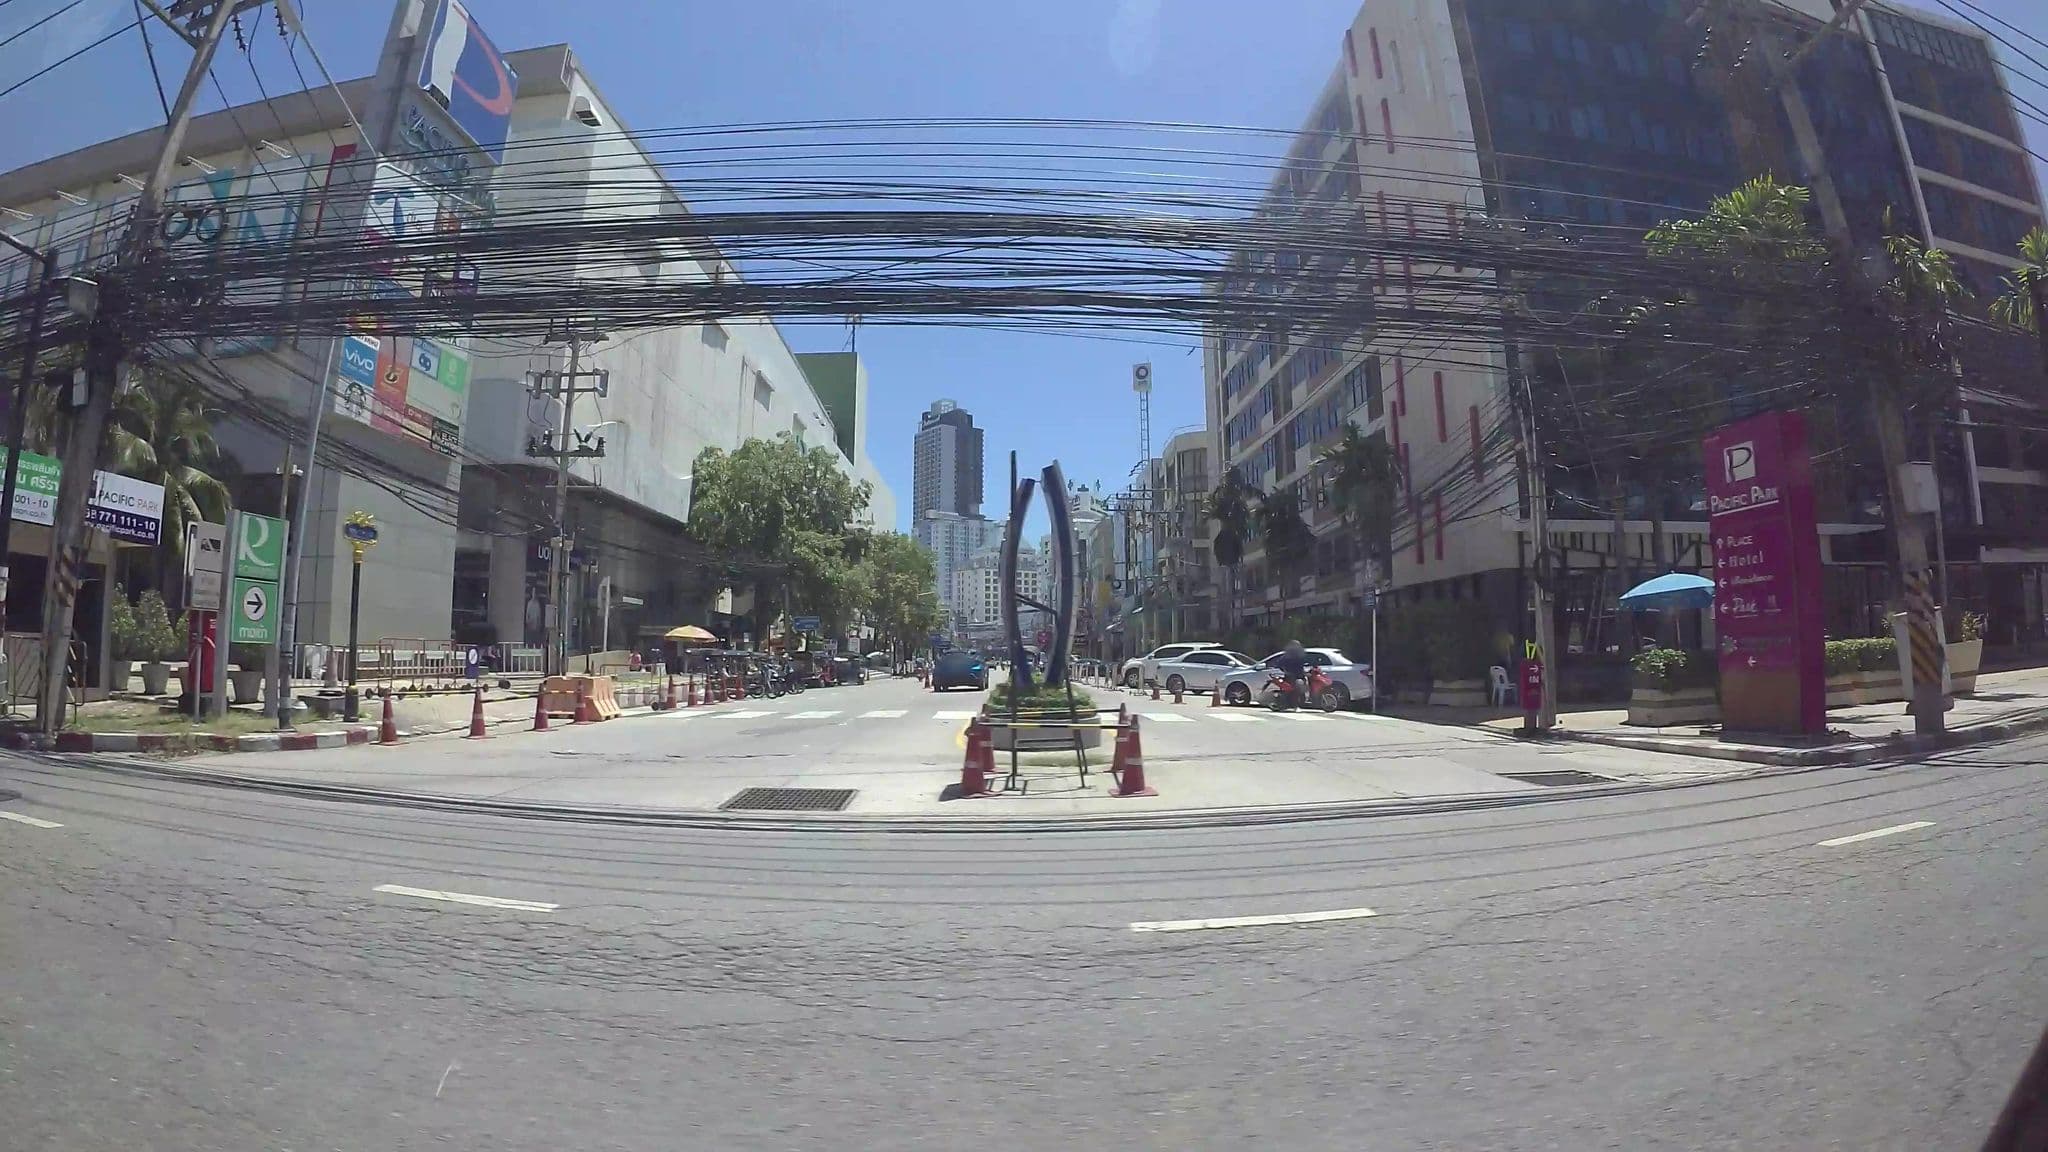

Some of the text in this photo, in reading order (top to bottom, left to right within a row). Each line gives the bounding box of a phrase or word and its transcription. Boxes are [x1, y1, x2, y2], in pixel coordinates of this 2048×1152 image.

[345, 348, 375, 372] vivo
[99, 489, 159, 513] PACIFIC PARK
[1711, 486, 1778, 512] PACIFIC PARK
[99, 510, 117, 524] 771
[120, 515, 156, 531] 111-10
[1728, 550, 1764, 568] Hotel
